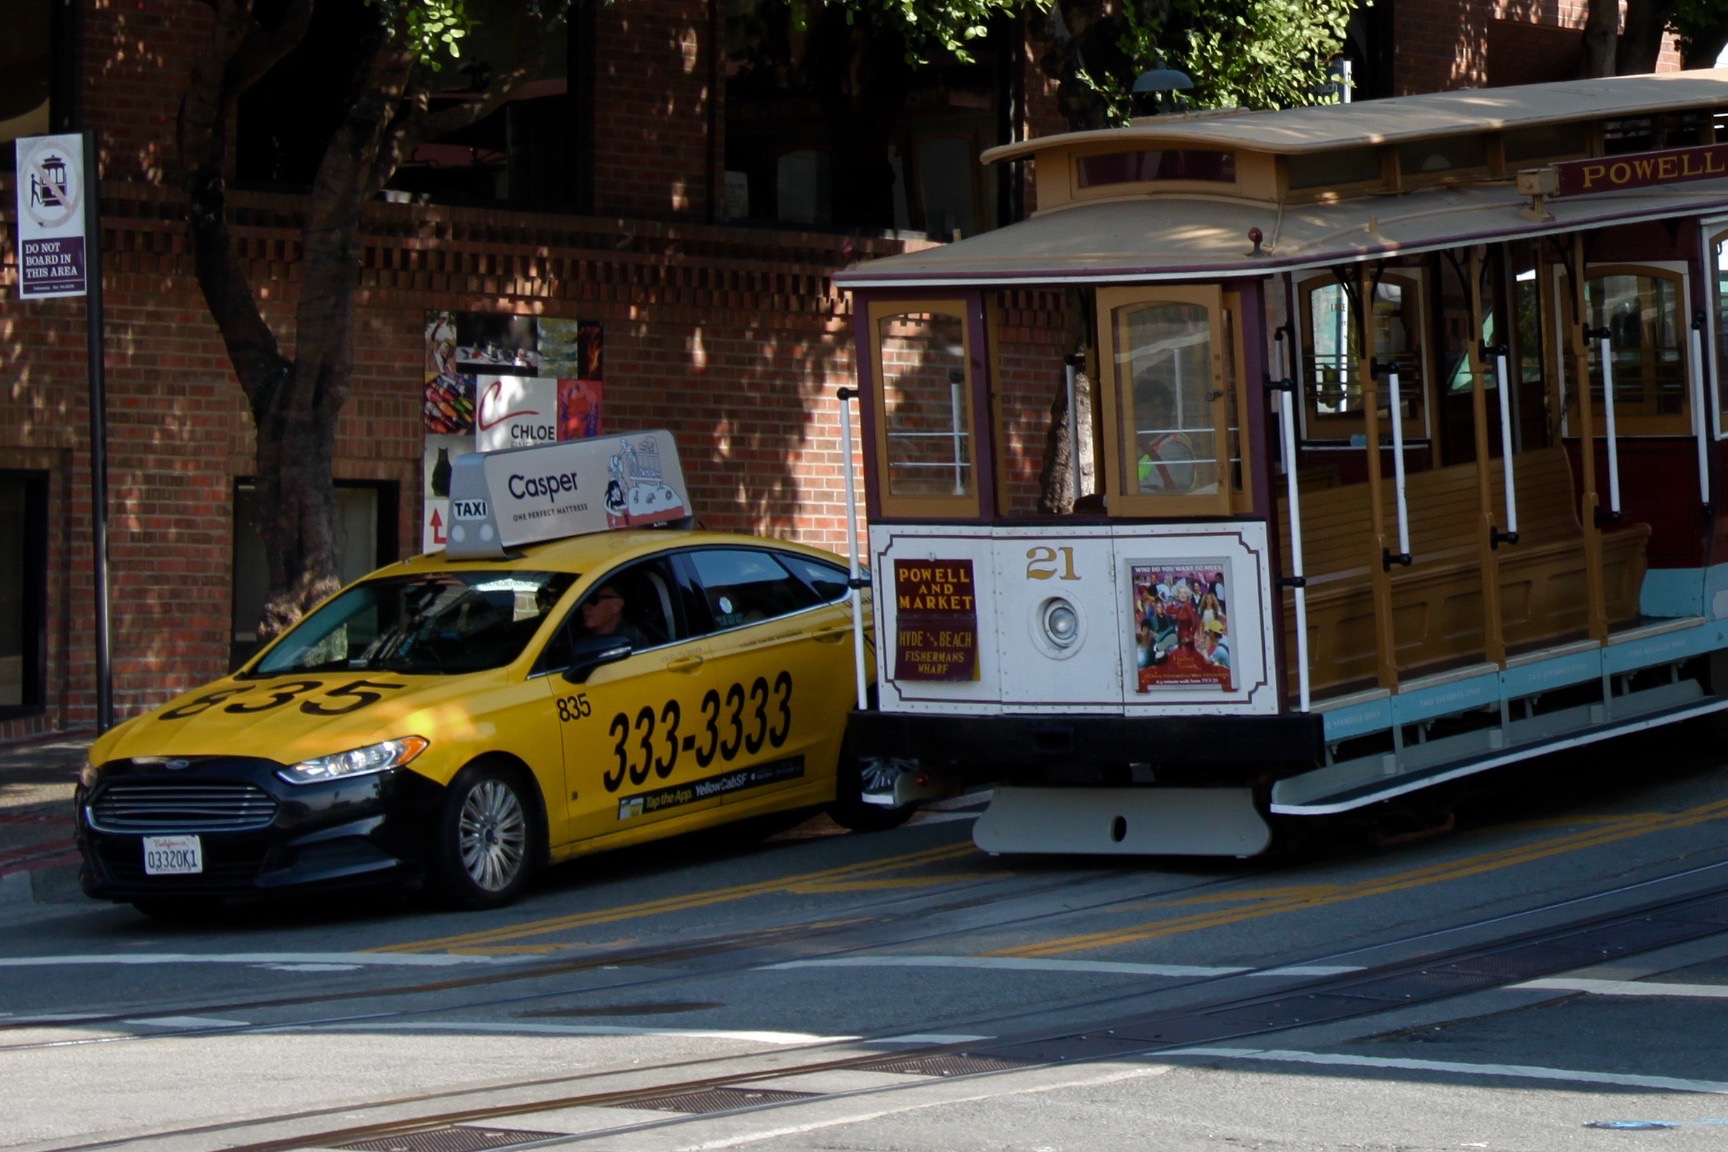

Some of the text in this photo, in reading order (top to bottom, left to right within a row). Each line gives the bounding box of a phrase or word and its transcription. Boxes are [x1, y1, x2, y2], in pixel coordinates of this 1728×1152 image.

[1581, 151, 1727, 189] POWELL
[25, 241, 61, 255] DO NOT
[26, 253, 72, 267] BOARD IN
[26, 265, 78, 279] THIS AREA
[511, 424, 555, 441] CHLOE
[508, 471, 578, 503] Casper
[454, 501, 488, 518] TAXI
[512, 502, 589, 522] ONE PERFECT MATTRESS
[1025, 546, 1082, 581] 21
[899, 567, 970, 584] POWELL
[917, 583, 955, 595] AND
[899, 595, 973, 610] MARKET
[900, 630, 924, 648] HYDE
[939, 630, 973, 648] BEACH
[904, 649, 965, 664] FISHERMANS
[917, 662, 950, 675] WHARF
[158, 679, 407, 721] 835
[556, 693, 592, 723] 835
[603, 670, 793, 794] 333-3333
[695, 772, 749, 797] YellowCabSF
[147, 849, 199, 871] 03320K1
